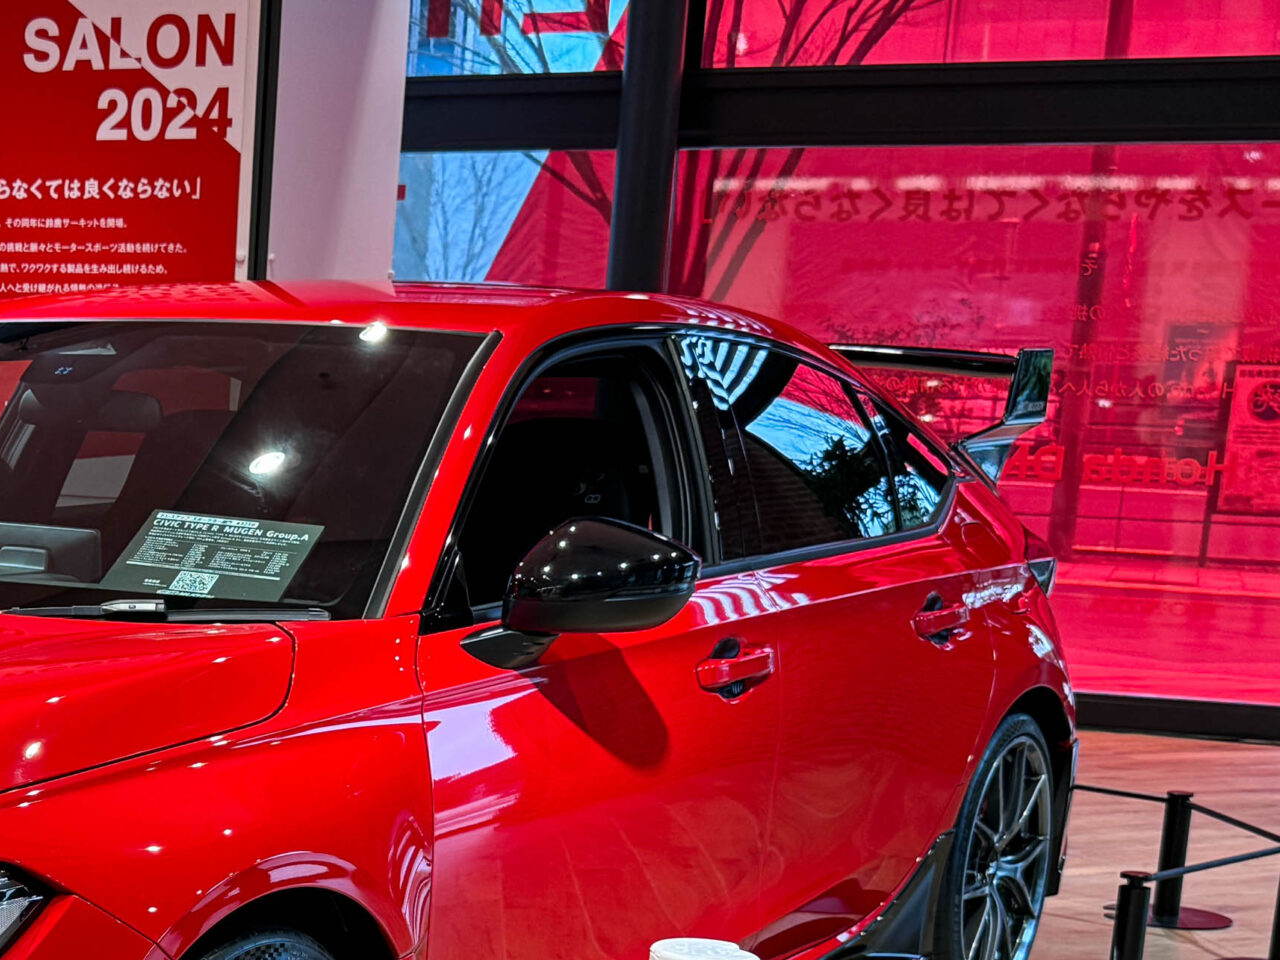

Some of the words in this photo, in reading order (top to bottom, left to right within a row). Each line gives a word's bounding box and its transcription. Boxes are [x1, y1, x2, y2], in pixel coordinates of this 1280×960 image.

[23, 13, 236, 73] SALON
[95, 86, 233, 142] 2024
[153, 518, 180, 528] CIVIC
[183, 521, 209, 531] TYPE
[210, 524, 219, 532] R
[223, 525, 264, 537] MUGEN
[266, 530, 309, 541] Group.A
